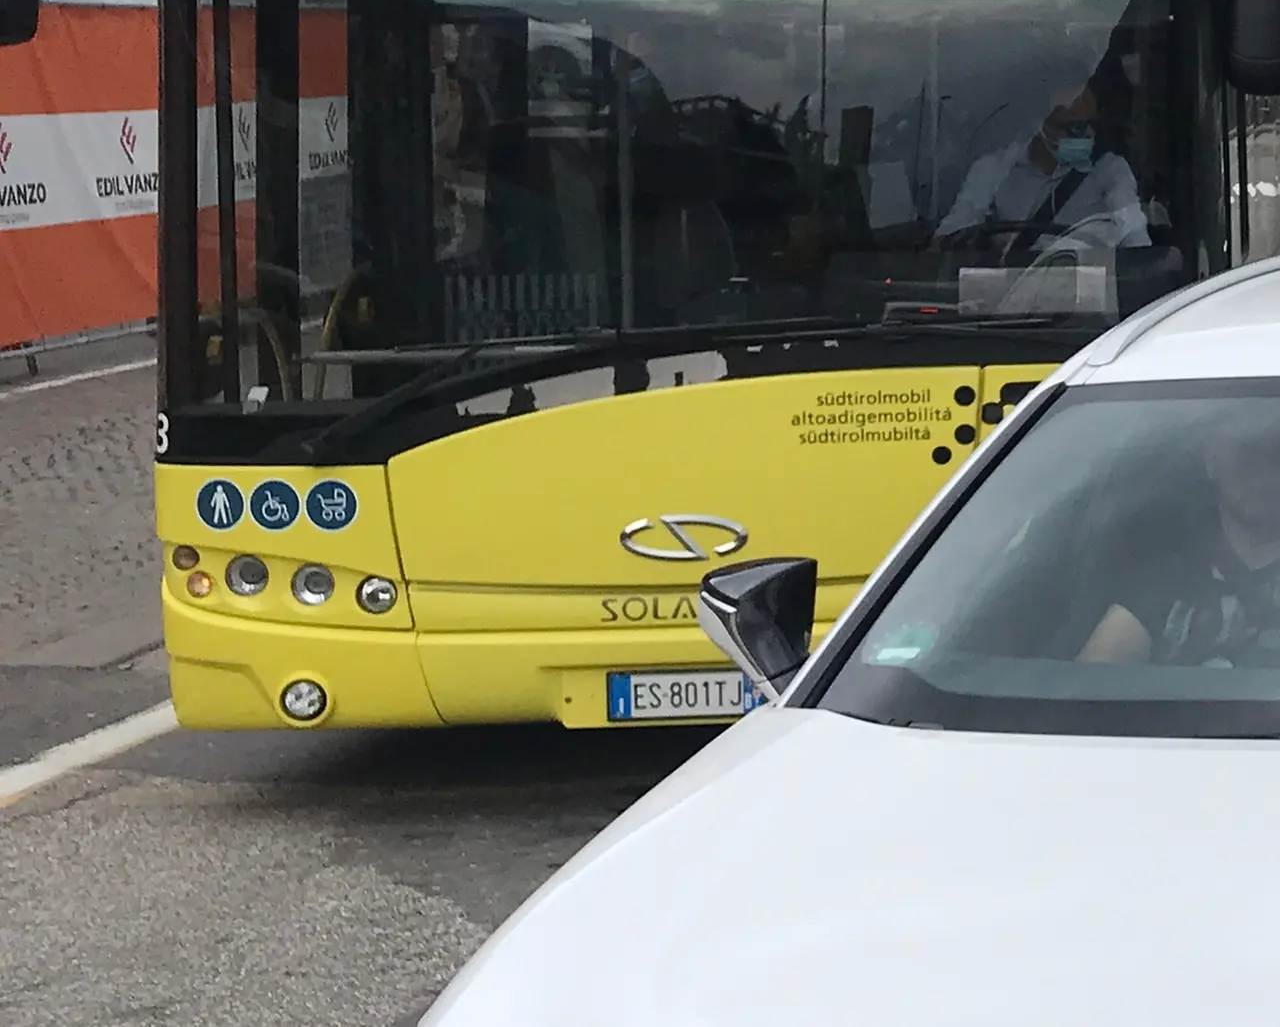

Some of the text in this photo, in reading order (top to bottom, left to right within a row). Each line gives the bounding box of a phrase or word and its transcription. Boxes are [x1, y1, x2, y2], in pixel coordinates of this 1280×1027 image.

[0, 183, 47, 206] VANZO
[96, 173, 158, 197] EDIL VANZ
[816, 389, 931, 406] südtirolmobil
[601, 596, 698, 623] SOLA
